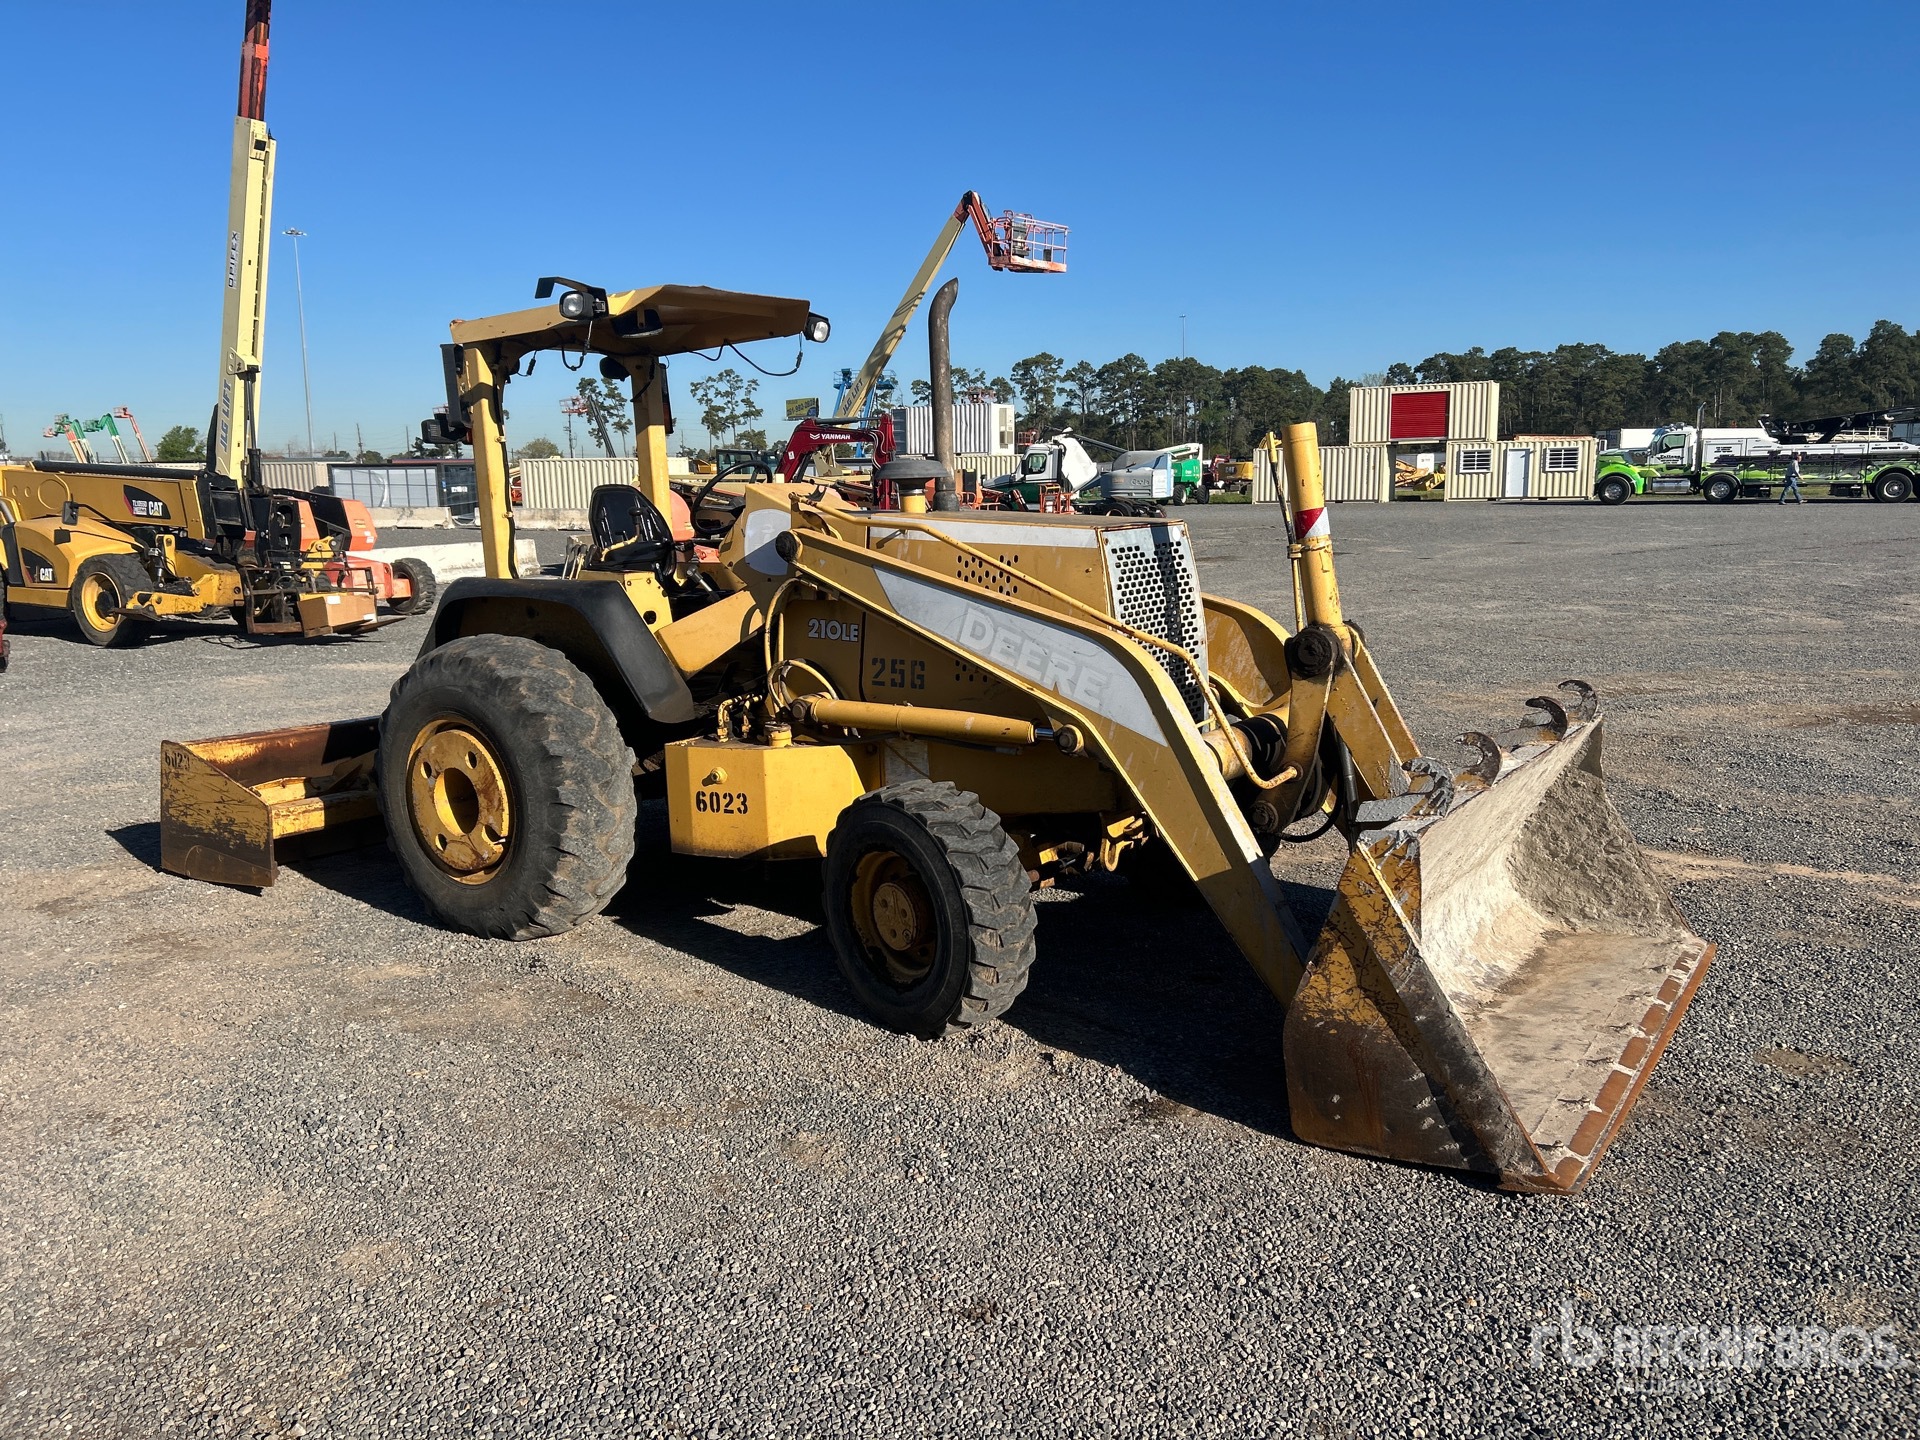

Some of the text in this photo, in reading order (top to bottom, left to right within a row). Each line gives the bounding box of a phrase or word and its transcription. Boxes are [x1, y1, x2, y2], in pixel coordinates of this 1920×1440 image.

[842, 378, 863, 415] JLG LIFT
[219, 379, 231, 453] JLG LIFT
[148, 501, 163, 516] CAT
[40, 568, 53, 581] CAT
[808, 618, 859, 642] 210LE
[958, 606, 1108, 707] DEERE
[695, 790, 748, 814] 6023
